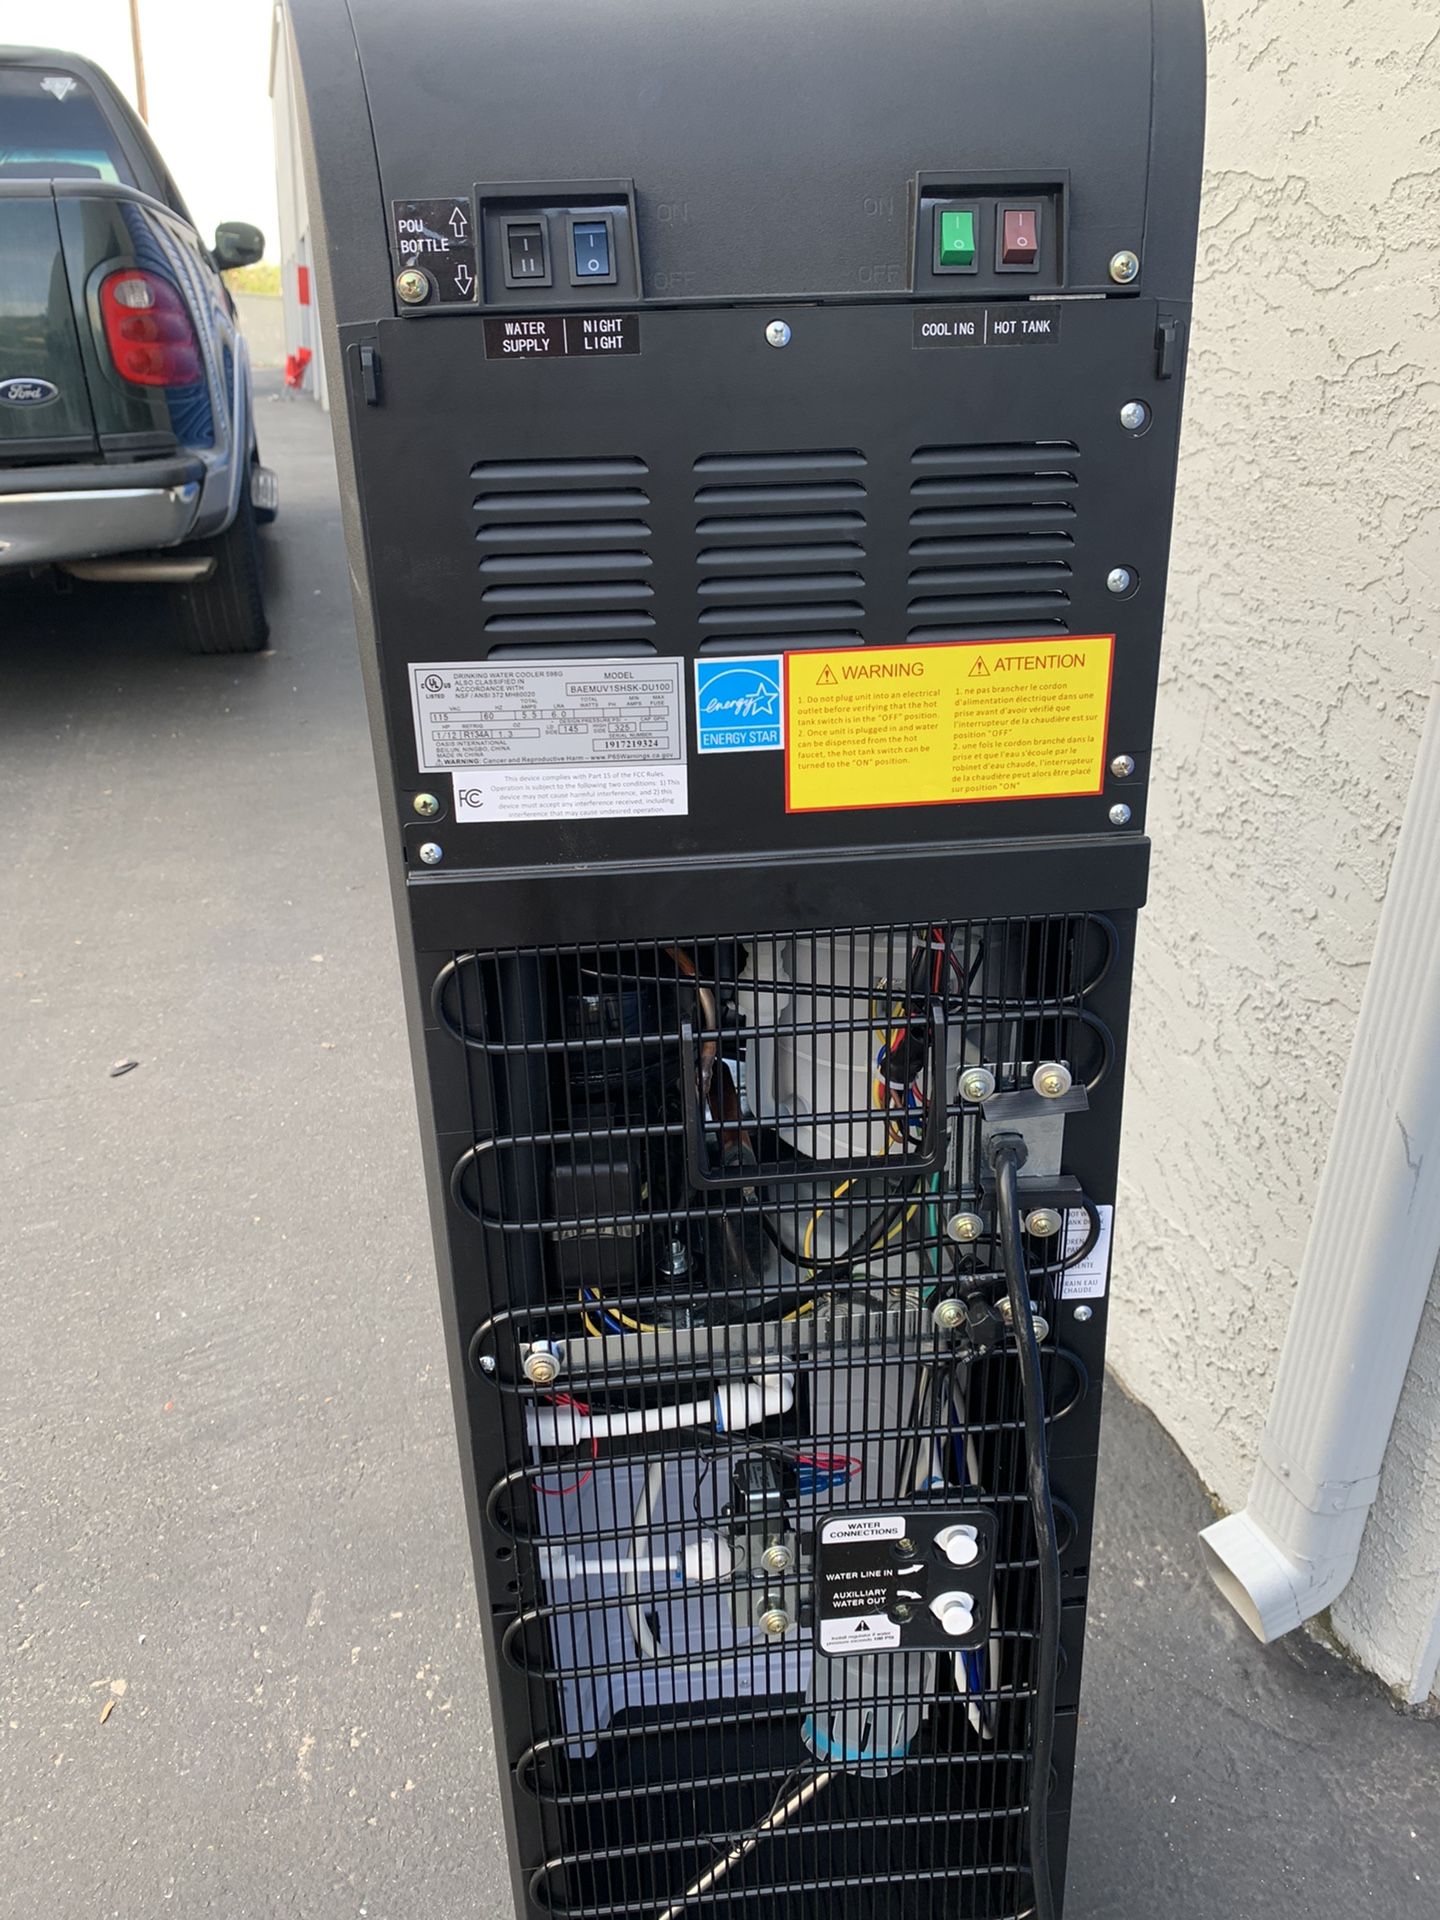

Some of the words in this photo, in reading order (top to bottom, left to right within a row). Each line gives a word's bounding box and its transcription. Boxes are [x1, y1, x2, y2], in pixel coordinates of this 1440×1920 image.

[398, 220, 423, 233] POU
[401, 239, 449, 253] BOTTLE
[505, 322, 545, 335] WATER
[584, 319, 622, 332] NIGHT
[922, 322, 974, 336] COOLING
[994, 321, 1016, 334] HOT
[1022, 320, 1050, 334] TANK
[503, 339, 549, 352] SUPPLY
[585, 336, 624, 349] LIGHT
[8, 384, 42, 400] Ford
[994, 653, 1085, 671] ATTENTION
[842, 662, 924, 679] WARNING
[992, 684, 1028, 693] brancher
[1038, 682, 1067, 690] cordon
[835, 694, 853, 704] plug
[855, 693, 871, 701] unit
[873, 692, 889, 700] into
[902, 689, 940, 698] electrical
[954, 696, 1014, 706] d'alimentation
[1016, 694, 1057, 705] électrique
[1058, 693, 1077, 701] dans
[702, 698, 754, 717] energy
[797, 706, 822, 714] outlet
[823, 705, 851, 713] before
[852, 703, 888, 714] verifying
[889, 702, 906, 710] that
[954, 709, 974, 719] prise
[976, 708, 998, 716] avant
[1000, 706, 1027, 715] d'avoir
[798, 717, 816, 726] tank
[817, 716, 843, 725] switch
[954, 718, 1008, 730] l'interrupteur
[1030, 715, 1070, 724] chaudière
[807, 728, 828, 736] Once
[829, 727, 845, 735] unit
[855, 725, 888, 736] plugged
[915, 723, 938, 731] water
[953, 730, 986, 741] position
[703, 731, 746, 745] ENERGY
[750, 731, 777, 743] STAR
[825, 737, 866, 748] dispensed
[867, 736, 887, 744] from
[1004, 739, 1032, 747] cordon
[1033, 737, 1066, 746] branché
[1067, 736, 1086, 744] dans
[858, 748, 875, 756] tank
[877, 746, 903, 755] switch
[952, 752, 972, 762] prise
[1000, 750, 1020, 758] l'eau
[798, 761, 825, 769] turned
[952, 763, 981, 771] robinet
[982, 762, 1005, 770] d'eau
[1040, 757, 1093, 769] l'interrupteur
[972, 772, 1010, 781] chaudière
[1012, 771, 1030, 781] peut
[1031, 770, 1051, 778] alors
[1053, 769, 1069, 777] être
[1070, 768, 1091, 778] placé
[964, 783, 997, 794] position
[830, 1528, 898, 1538] CONNECTIONS
[826, 1572, 858, 1581] WATER
[833, 1589, 886, 1599] AUXILLIARY
[833, 1600, 864, 1608] WATER
